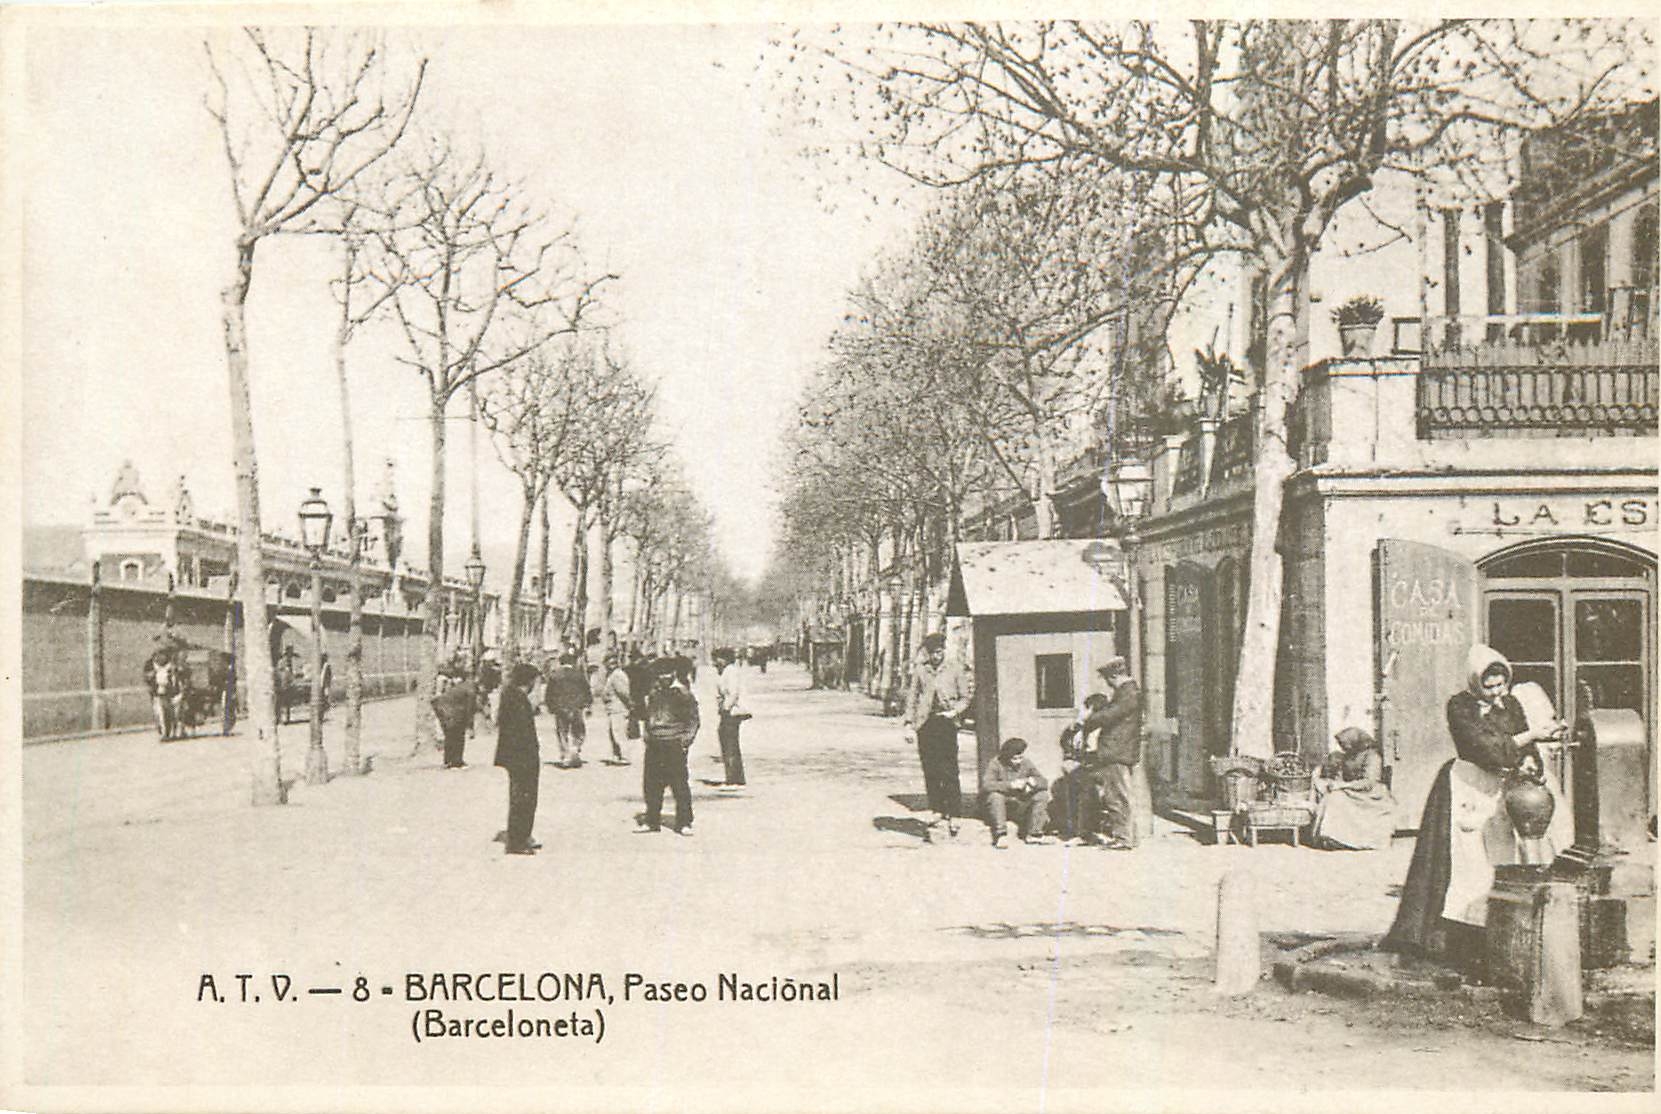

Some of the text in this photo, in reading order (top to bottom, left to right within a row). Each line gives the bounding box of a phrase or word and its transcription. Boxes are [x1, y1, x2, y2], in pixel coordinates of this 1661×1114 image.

[1493, 500, 1659, 526] LA ES
[1391, 579, 1461, 609] CASA
